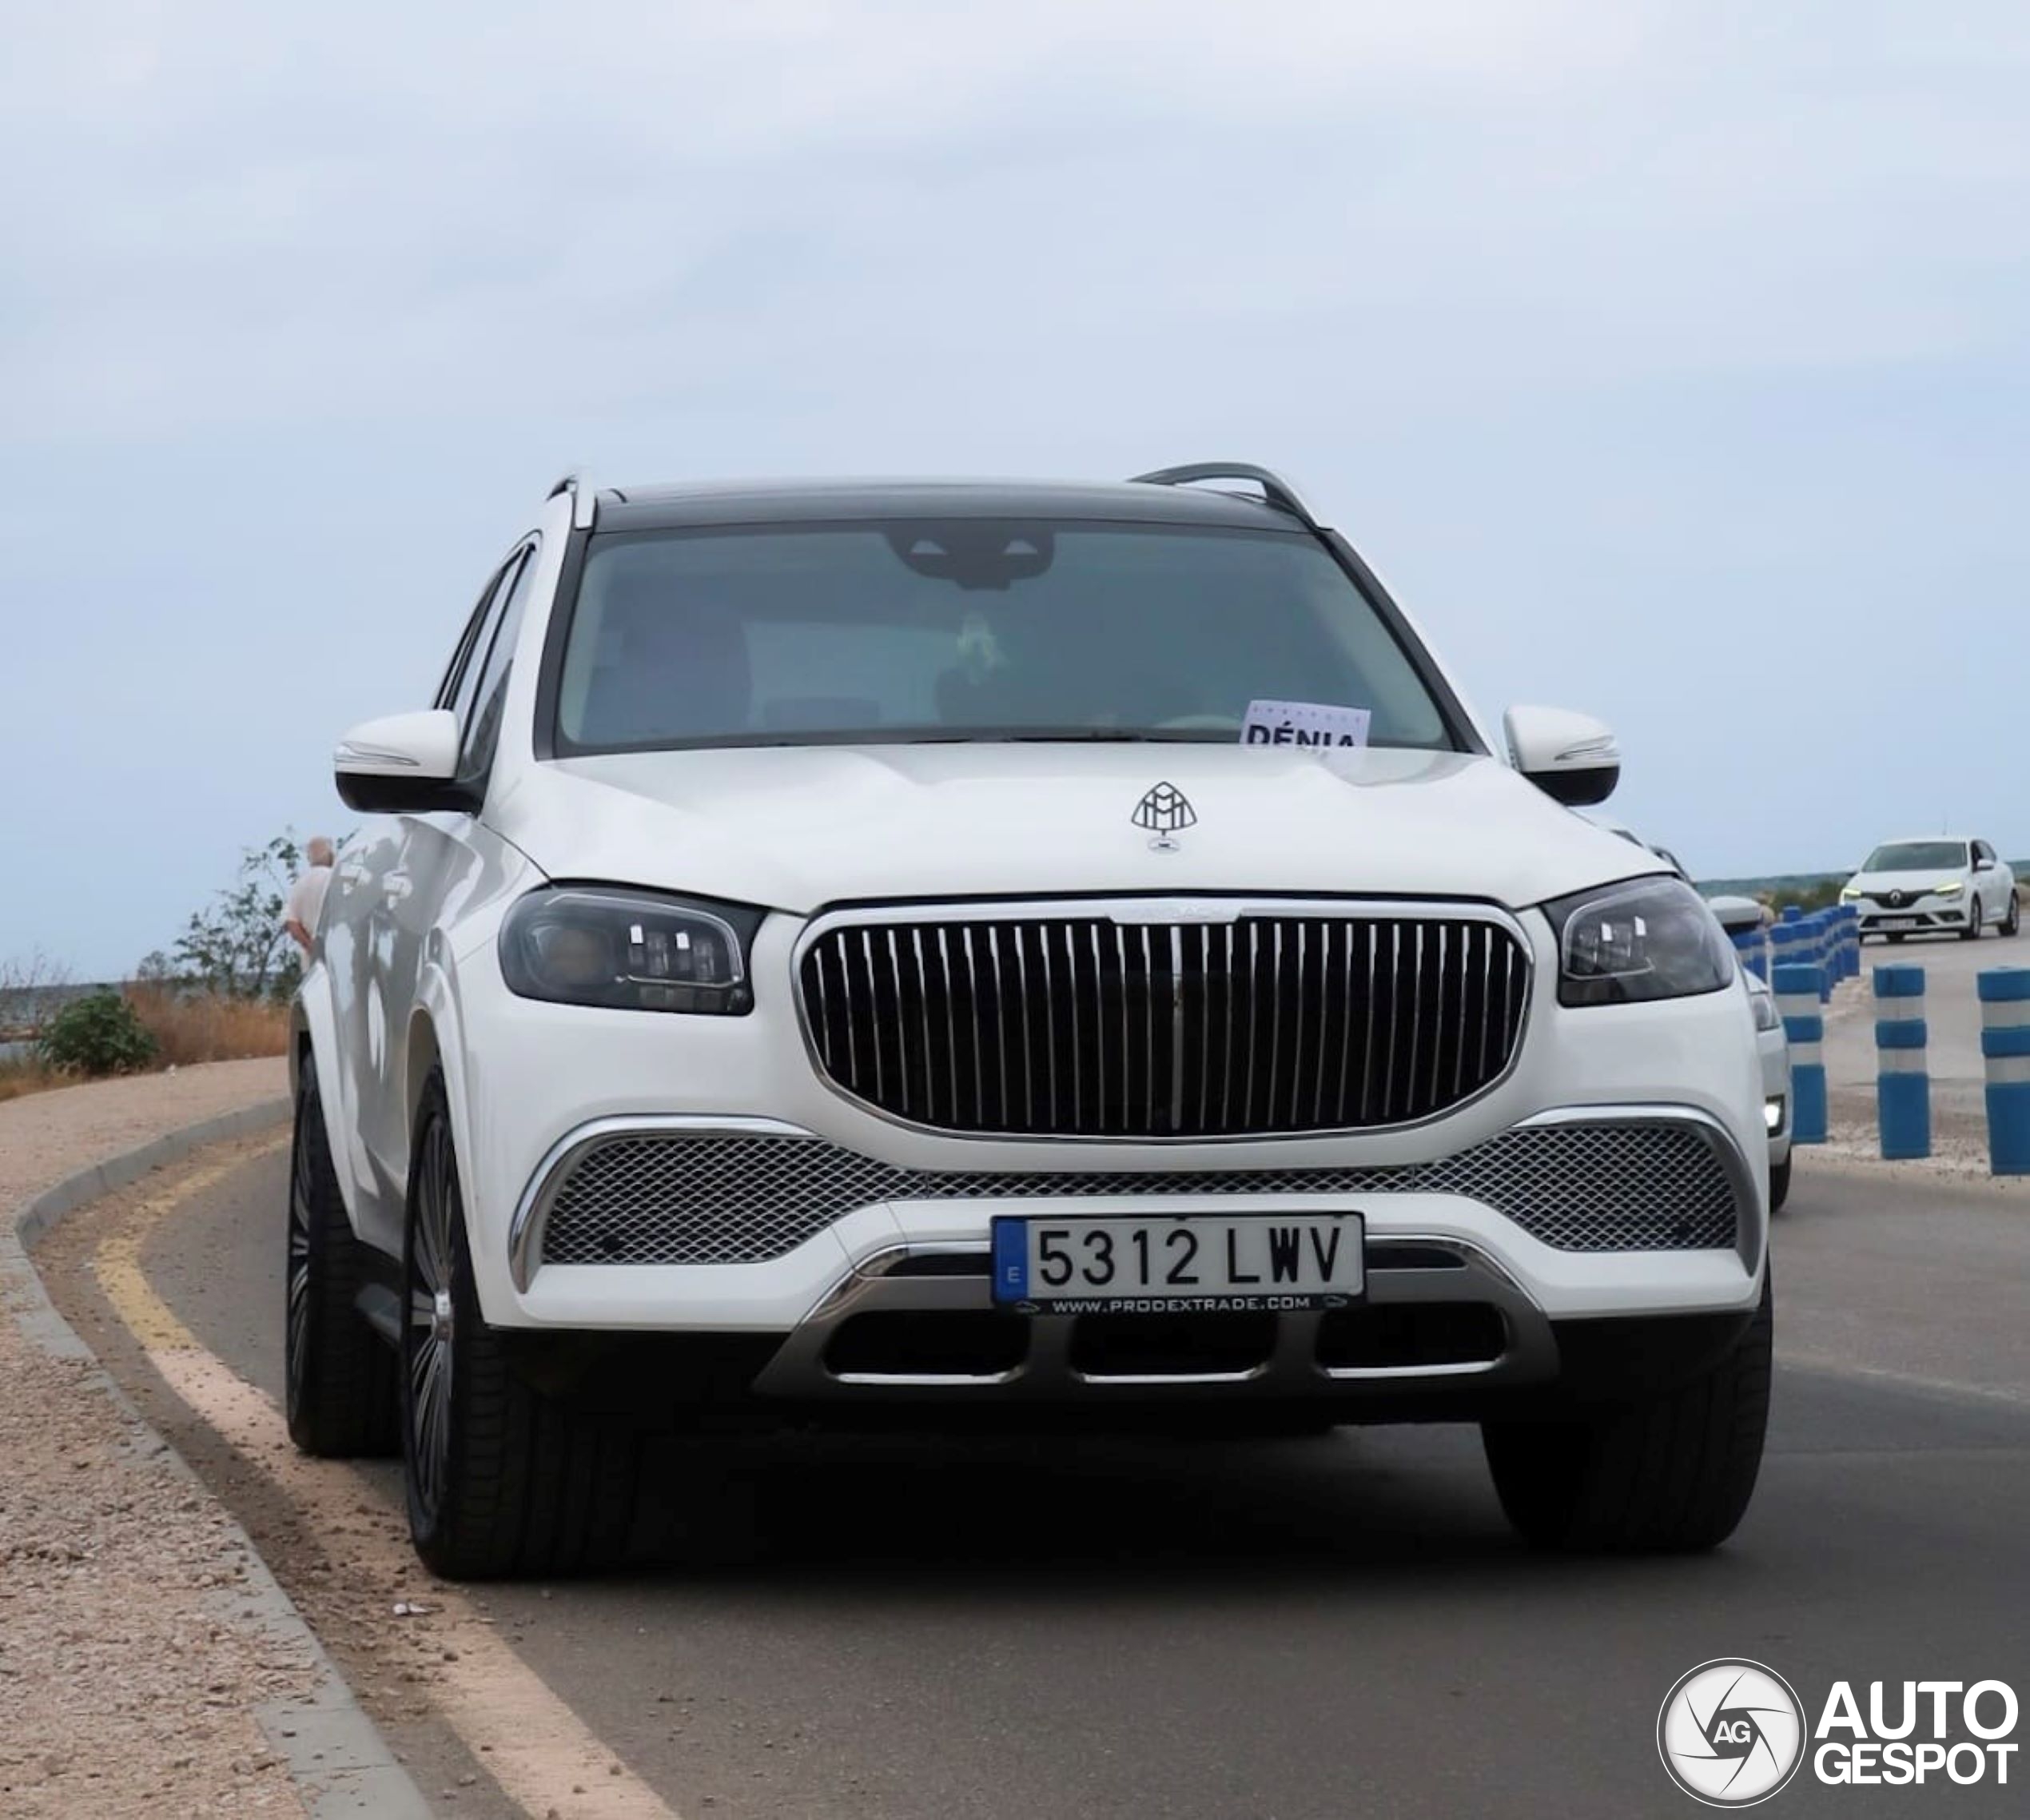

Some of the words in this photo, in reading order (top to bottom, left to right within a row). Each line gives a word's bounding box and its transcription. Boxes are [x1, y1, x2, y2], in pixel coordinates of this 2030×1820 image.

[1039, 1229, 1200, 1287] 5312
[1227, 1226, 1342, 1284] LWV
[1008, 1266, 1021, 1284] E
[1052, 1296, 1311, 1313] WWW.PRODEXTRADE.COM
